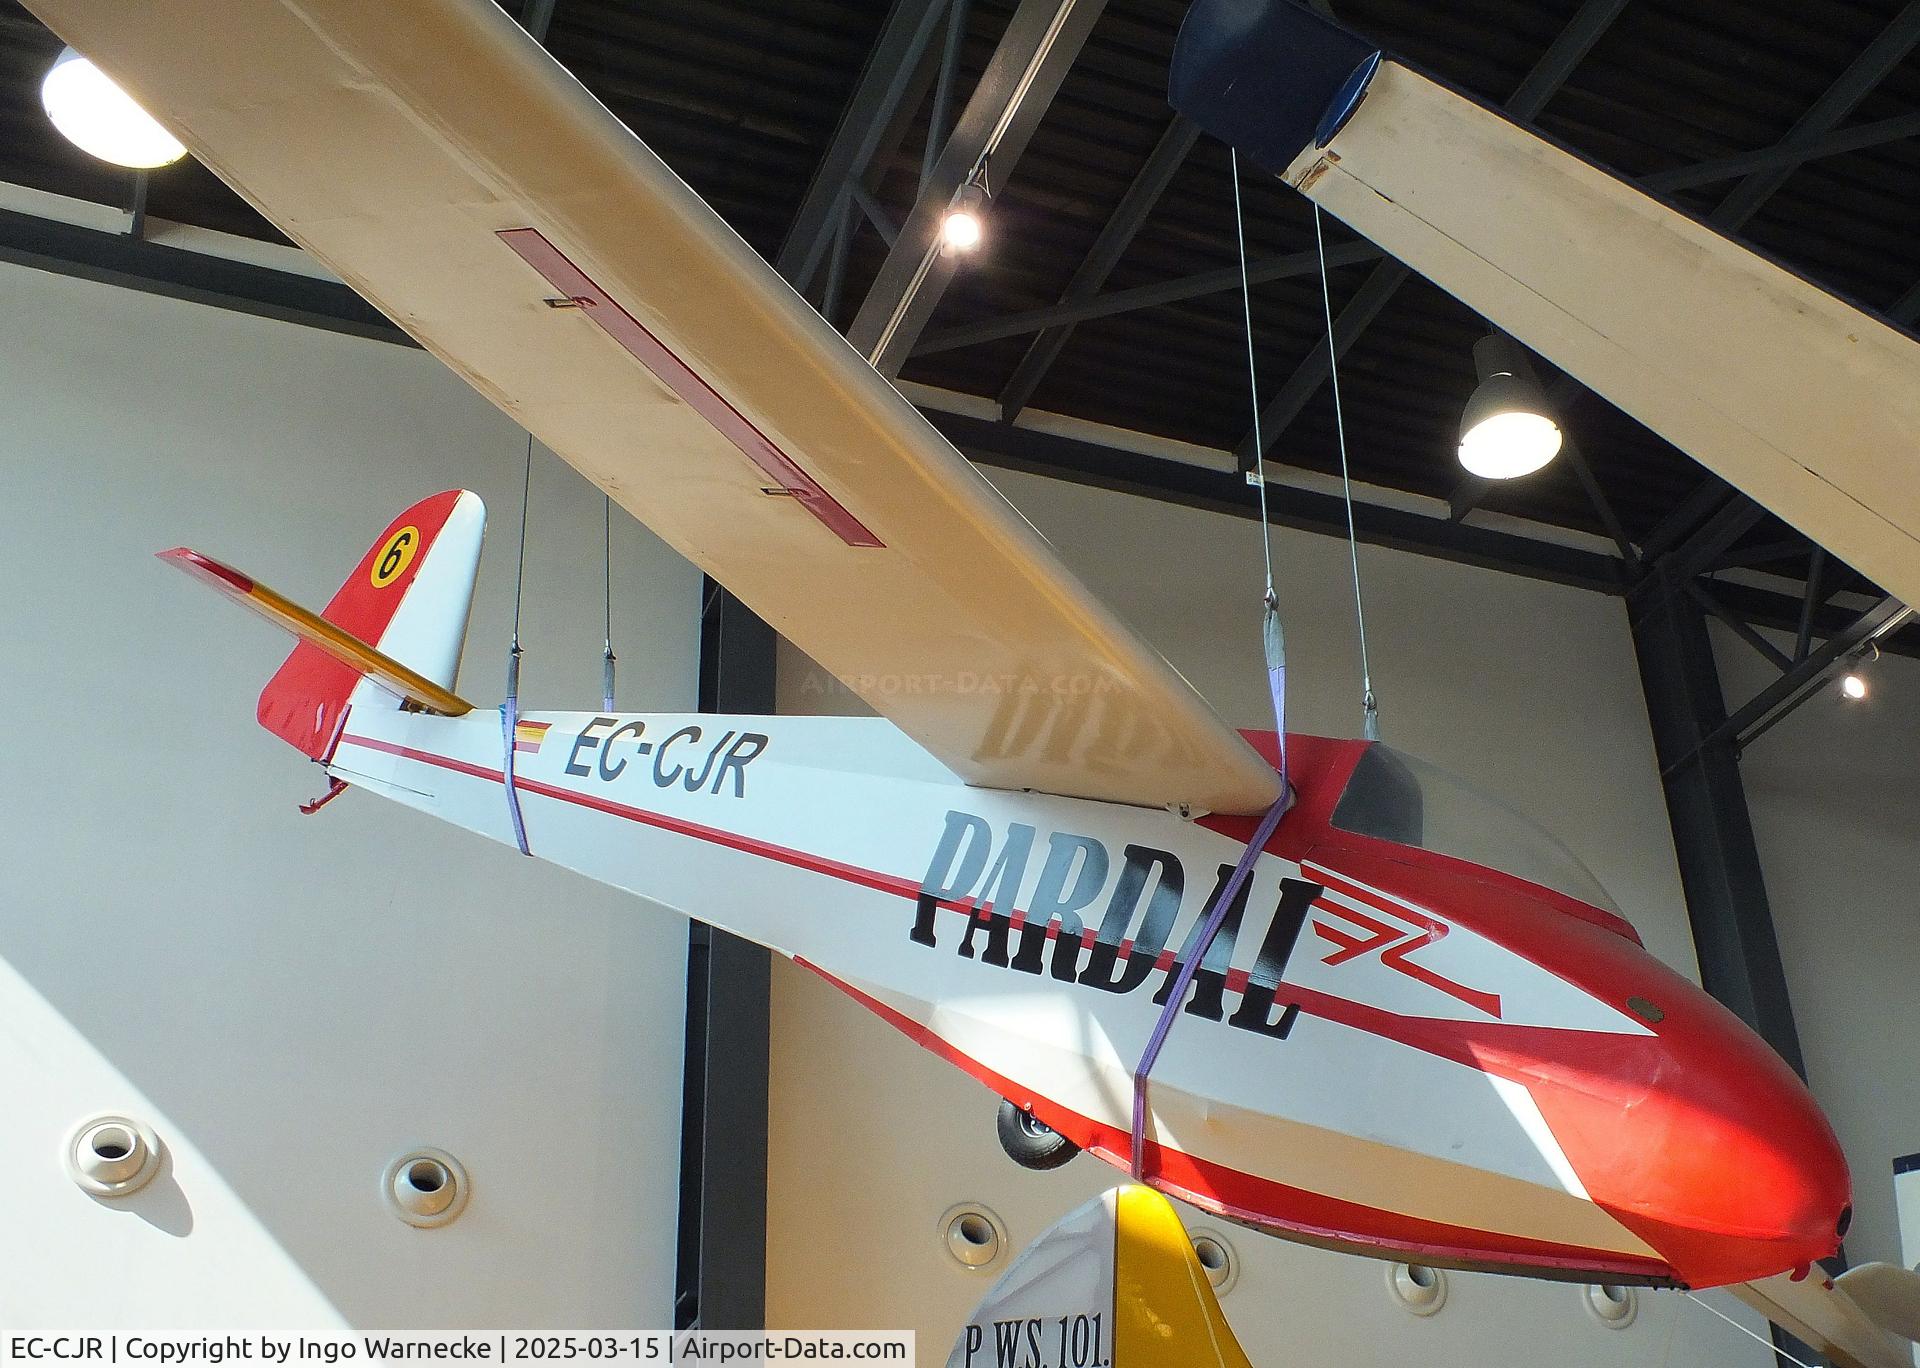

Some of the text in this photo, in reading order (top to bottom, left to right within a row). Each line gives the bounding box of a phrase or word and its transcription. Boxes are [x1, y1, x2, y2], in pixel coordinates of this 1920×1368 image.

[379, 533, 411, 579] 6
[565, 717, 769, 798] EC-CJR
[908, 810, 1324, 1040] PARDAL
[964, 1319, 1047, 1368] PW.S.
